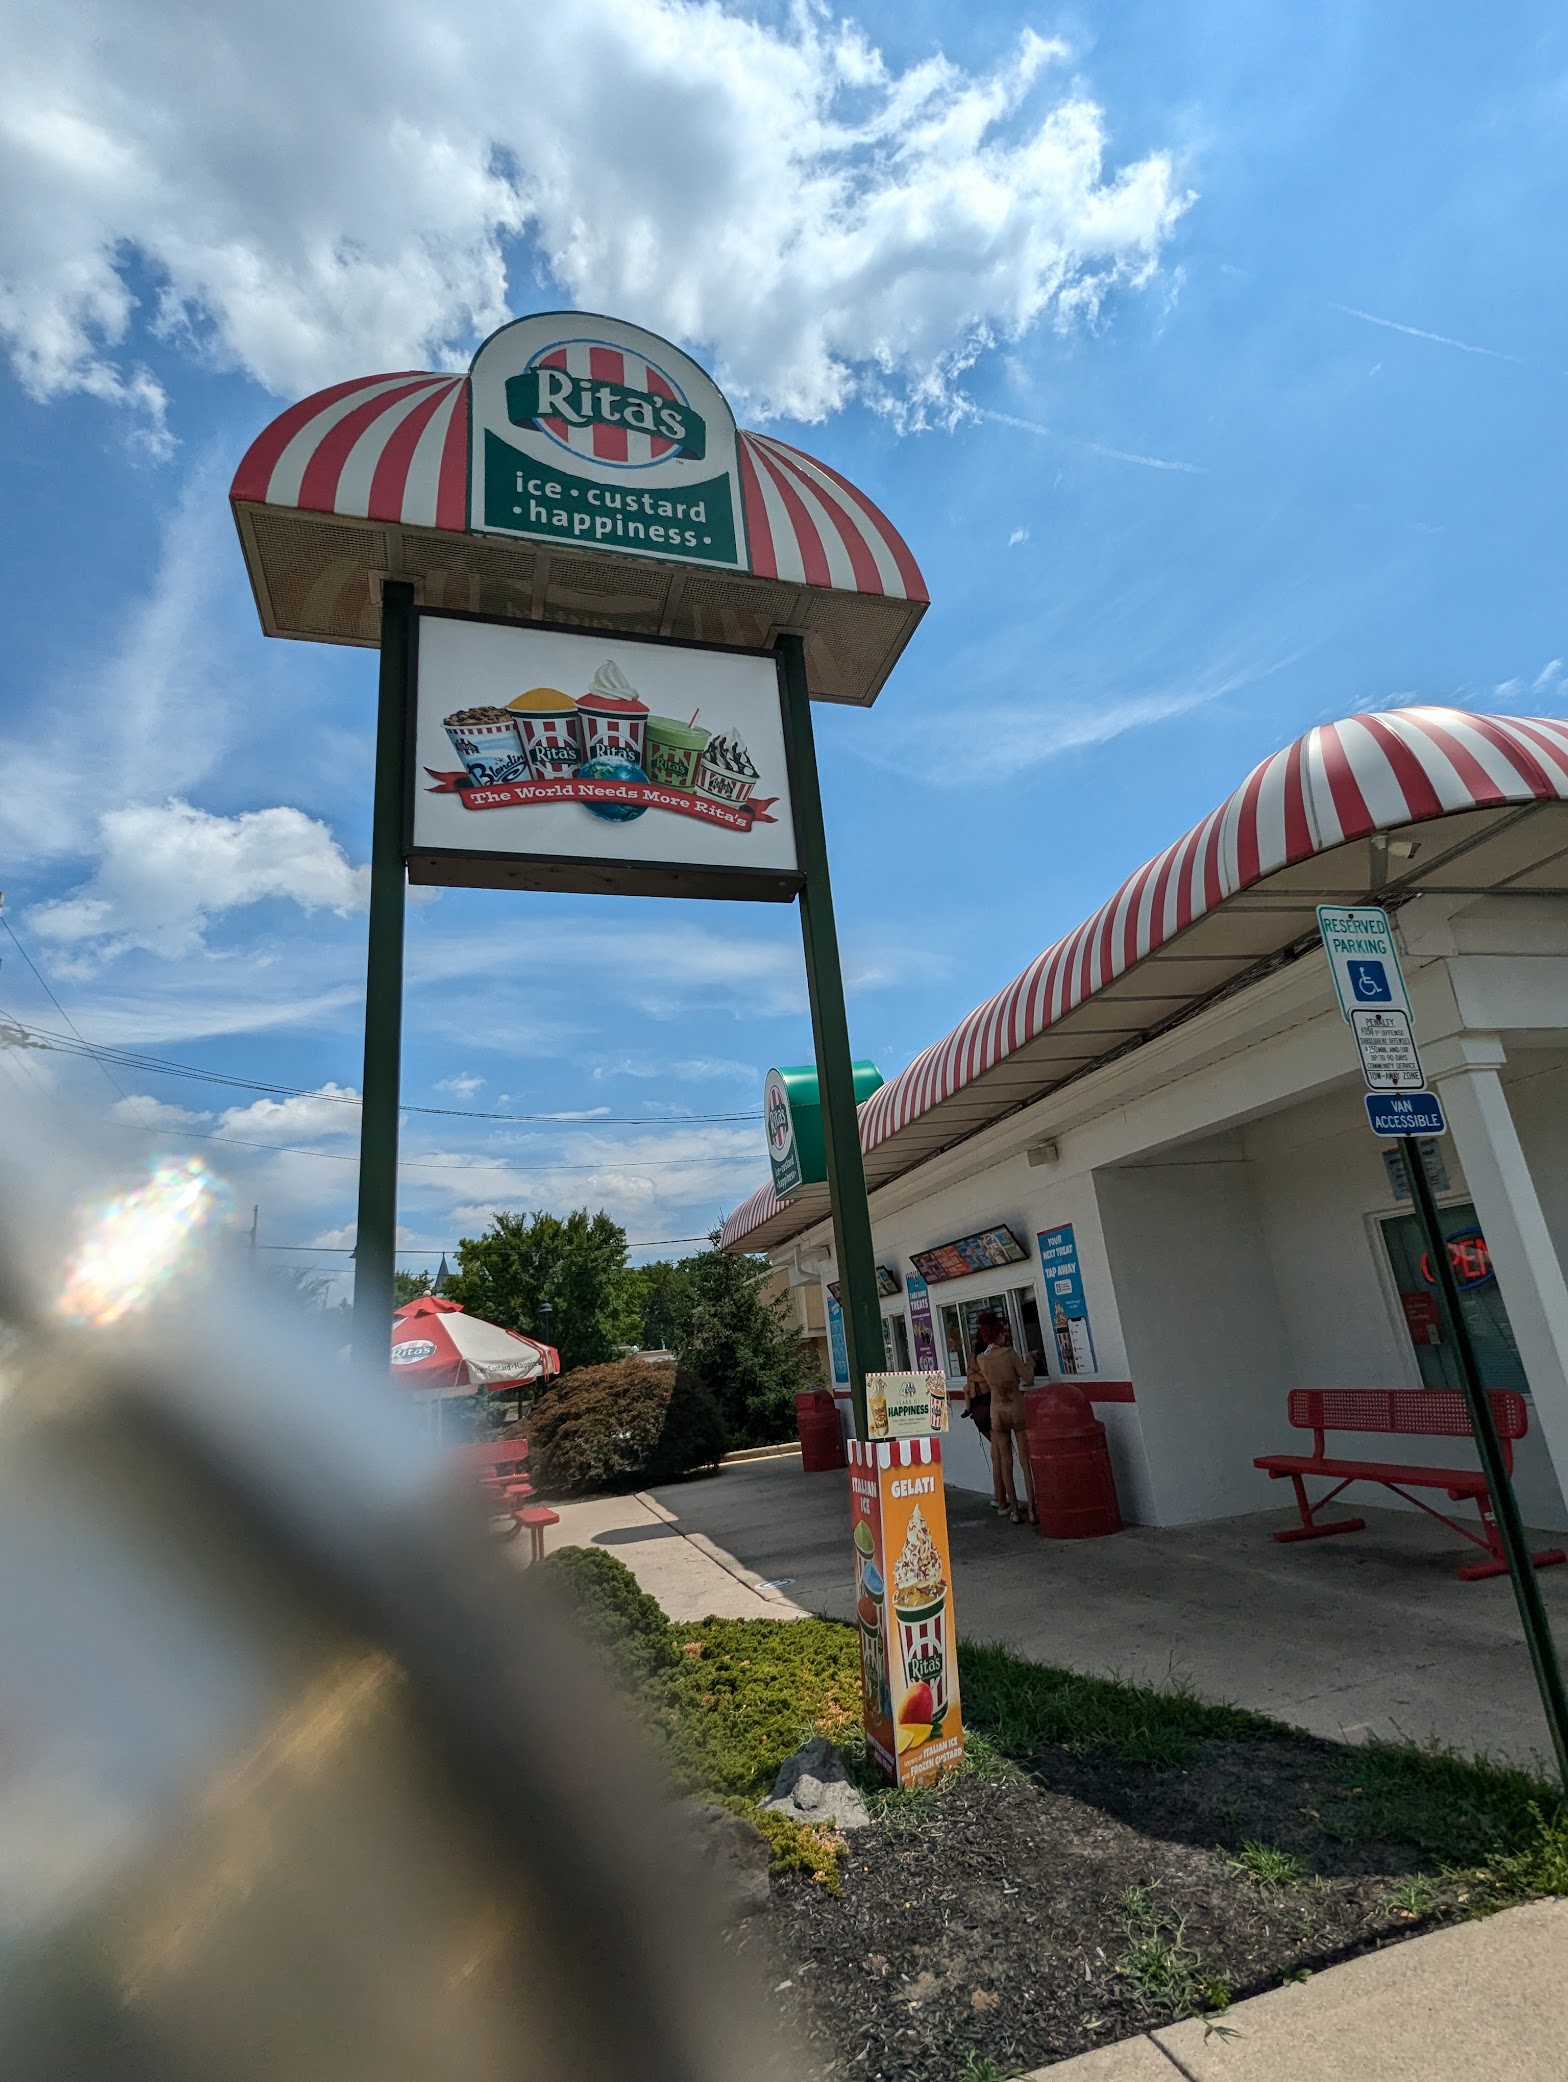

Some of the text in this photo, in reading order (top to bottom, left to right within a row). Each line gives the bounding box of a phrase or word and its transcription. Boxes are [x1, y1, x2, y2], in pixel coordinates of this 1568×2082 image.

[536, 369, 686, 440] Rita's
[515, 470, 707, 523] ice custard
[529, 499, 698, 548] happiness
[534, 746, 577, 761] Rita's
[595, 743, 636, 761] Rita's
[656, 757, 686, 774] Rita's
[470, 784, 747, 827] The World Needs More Rita's
[1323, 918, 1386, 935] RESERVED
[1333, 938, 1387, 955] PARKING
[1402, 1071, 1421, 1080] ZONE
[1390, 1100, 1414, 1114] VAN
[1375, 1114, 1441, 1128] ACCESSIBLE
[1045, 1262, 1077, 1279] TAP AWAY
[910, 1298, 929, 1312] TREATS
[391, 1345, 432, 1358] Rita's
[888, 1404, 929, 1418] HAPPINESS
[851, 1476, 877, 1498] ITALIAN
[891, 1476, 935, 1498] GELATI
[860, 1496, 871, 1515] ICE
[911, 1654, 942, 1679] Rita's
[923, 1741, 948, 1758] ITALIAN
[948, 1736, 958, 1749] ICE
[910, 1758, 935, 1777] FROZEN
